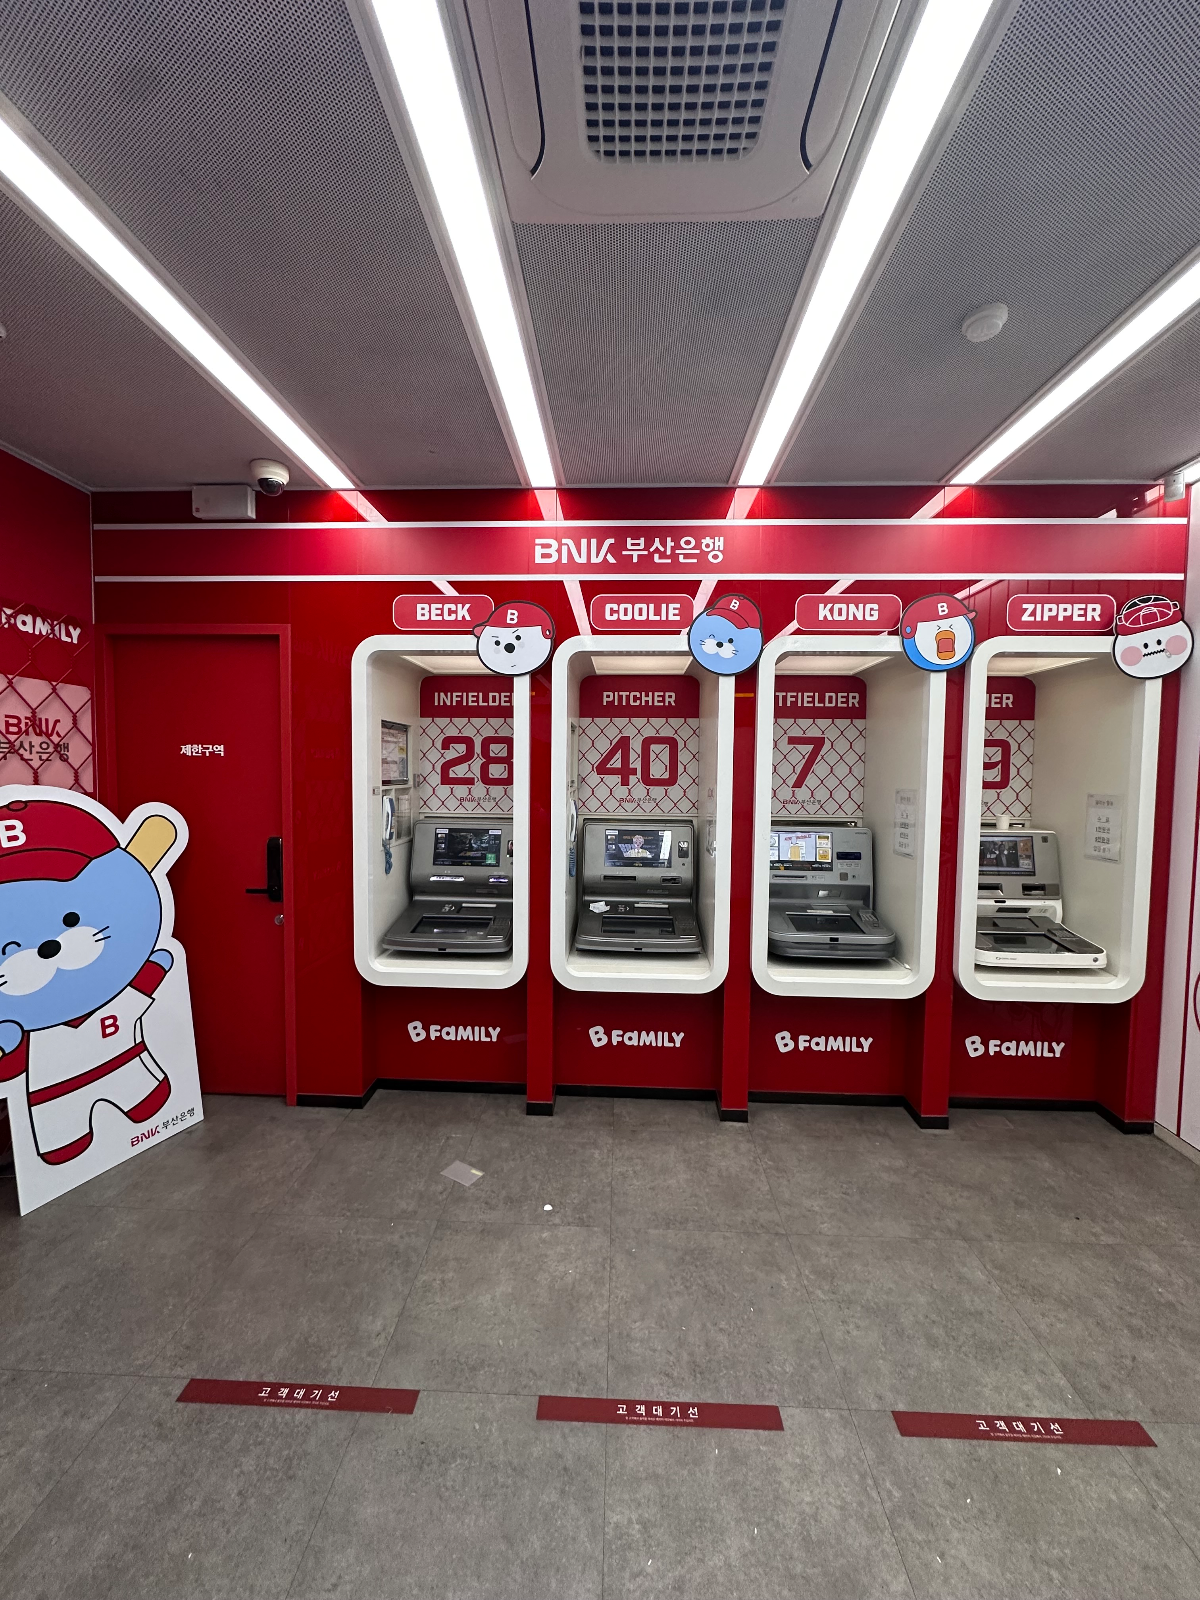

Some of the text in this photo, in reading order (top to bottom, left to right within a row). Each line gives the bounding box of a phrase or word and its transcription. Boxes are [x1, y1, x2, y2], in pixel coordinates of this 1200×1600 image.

[534, 536, 725, 564] BNK 부산은행
[416, 603, 472, 621] BECK
[604, 603, 681, 621] COOLIE
[729, 599, 740, 611] B
[818, 603, 879, 621] KONG
[937, 602, 949, 616] B
[1021, 603, 1101, 622] ZIPPER
[506, 609, 519, 625] B
[434, 692, 514, 706] INFIELDE
[602, 691, 676, 706] PITCHER
[775, 692, 860, 707] TFIELDER
[4, 714, 63, 738] BNK
[180, 744, 224, 757] 제한구역
[439, 735, 514, 787] 28
[595, 735, 679, 787] 40
[786, 735, 826, 789] 7
[0, 819, 27, 848] B
[100, 1014, 120, 1039] B
[407, 1020, 427, 1043] B
[588, 1025, 609, 1048] B
[775, 1030, 795, 1054] B
[965, 1035, 985, 1058] B
[130, 1107, 195, 1147] BNK 부산은행
